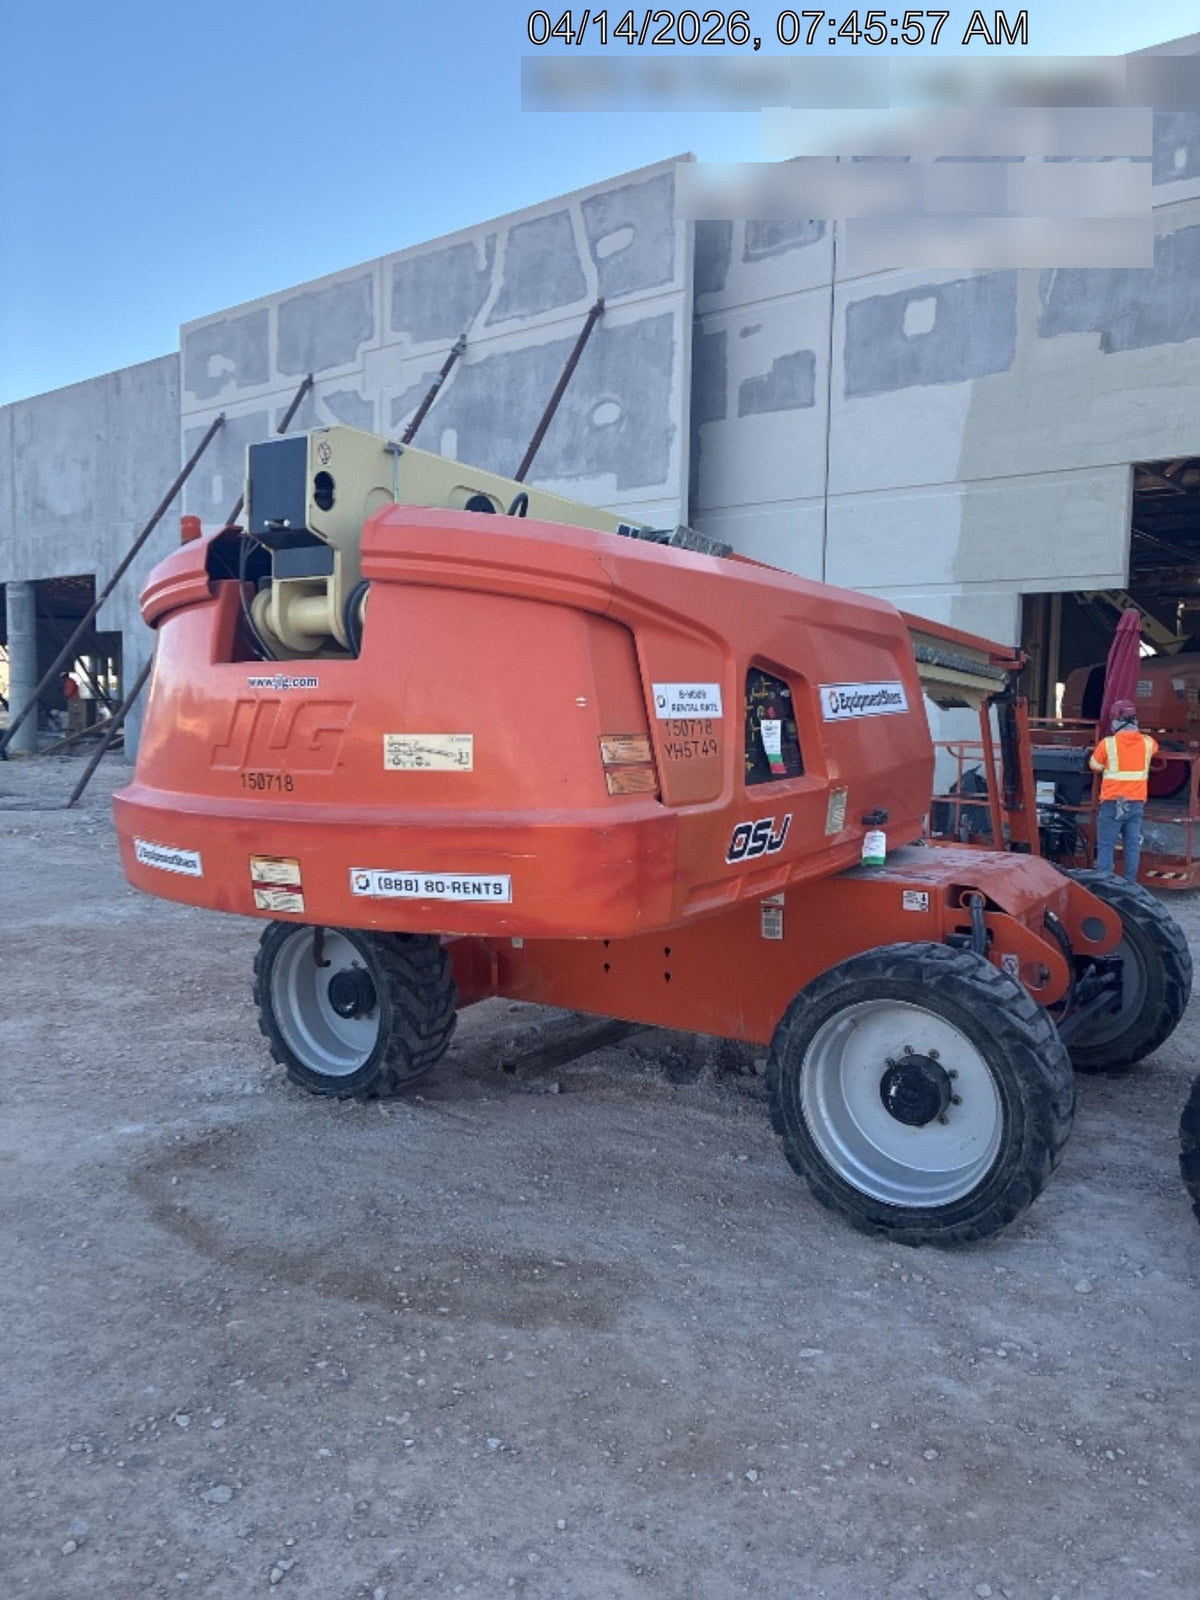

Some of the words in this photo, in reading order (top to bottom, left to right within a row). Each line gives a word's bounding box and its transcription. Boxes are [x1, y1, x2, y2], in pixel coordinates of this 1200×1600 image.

[248, 675, 318, 690] www.jlg.com
[664, 719, 713, 737] 150718
[240, 773, 295, 792] 150718
[725, 813, 792, 865] OSJ
